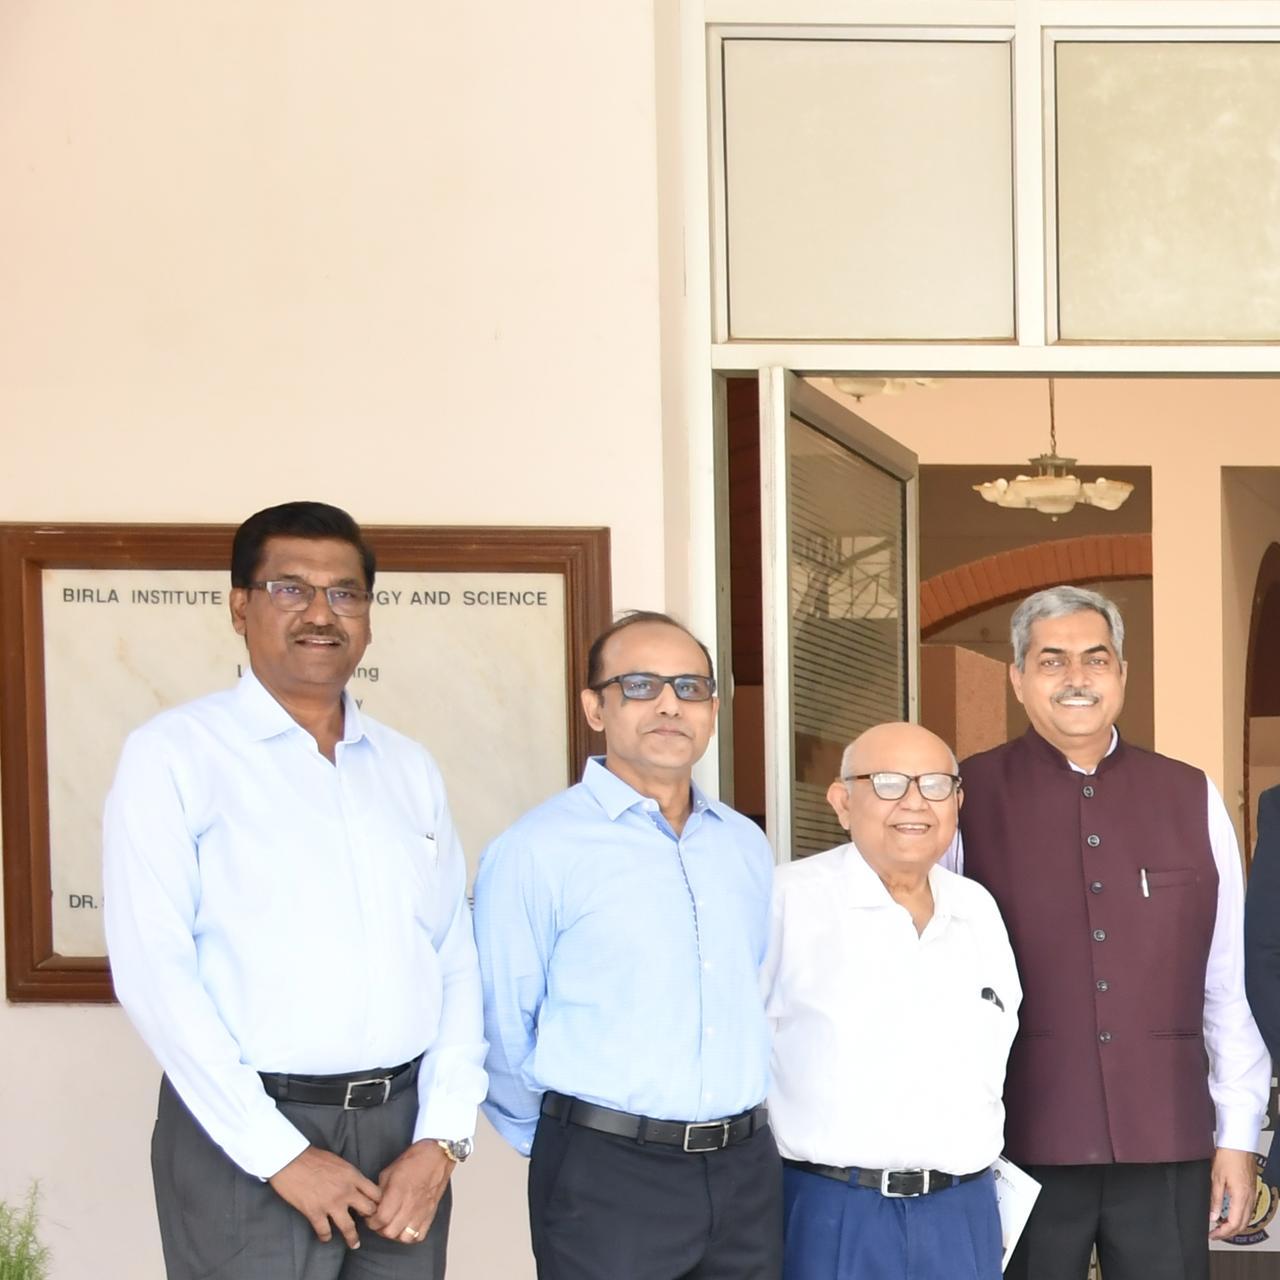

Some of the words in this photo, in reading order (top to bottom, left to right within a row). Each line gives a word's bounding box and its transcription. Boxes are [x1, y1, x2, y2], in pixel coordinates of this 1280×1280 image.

[63, 588, 120, 603] BIRLA
[131, 590, 223, 605] INSTITUTE
[410, 590, 451, 606] AND
[463, 591, 548, 606] SCIENCE
[69, 894, 98, 908] DR.
